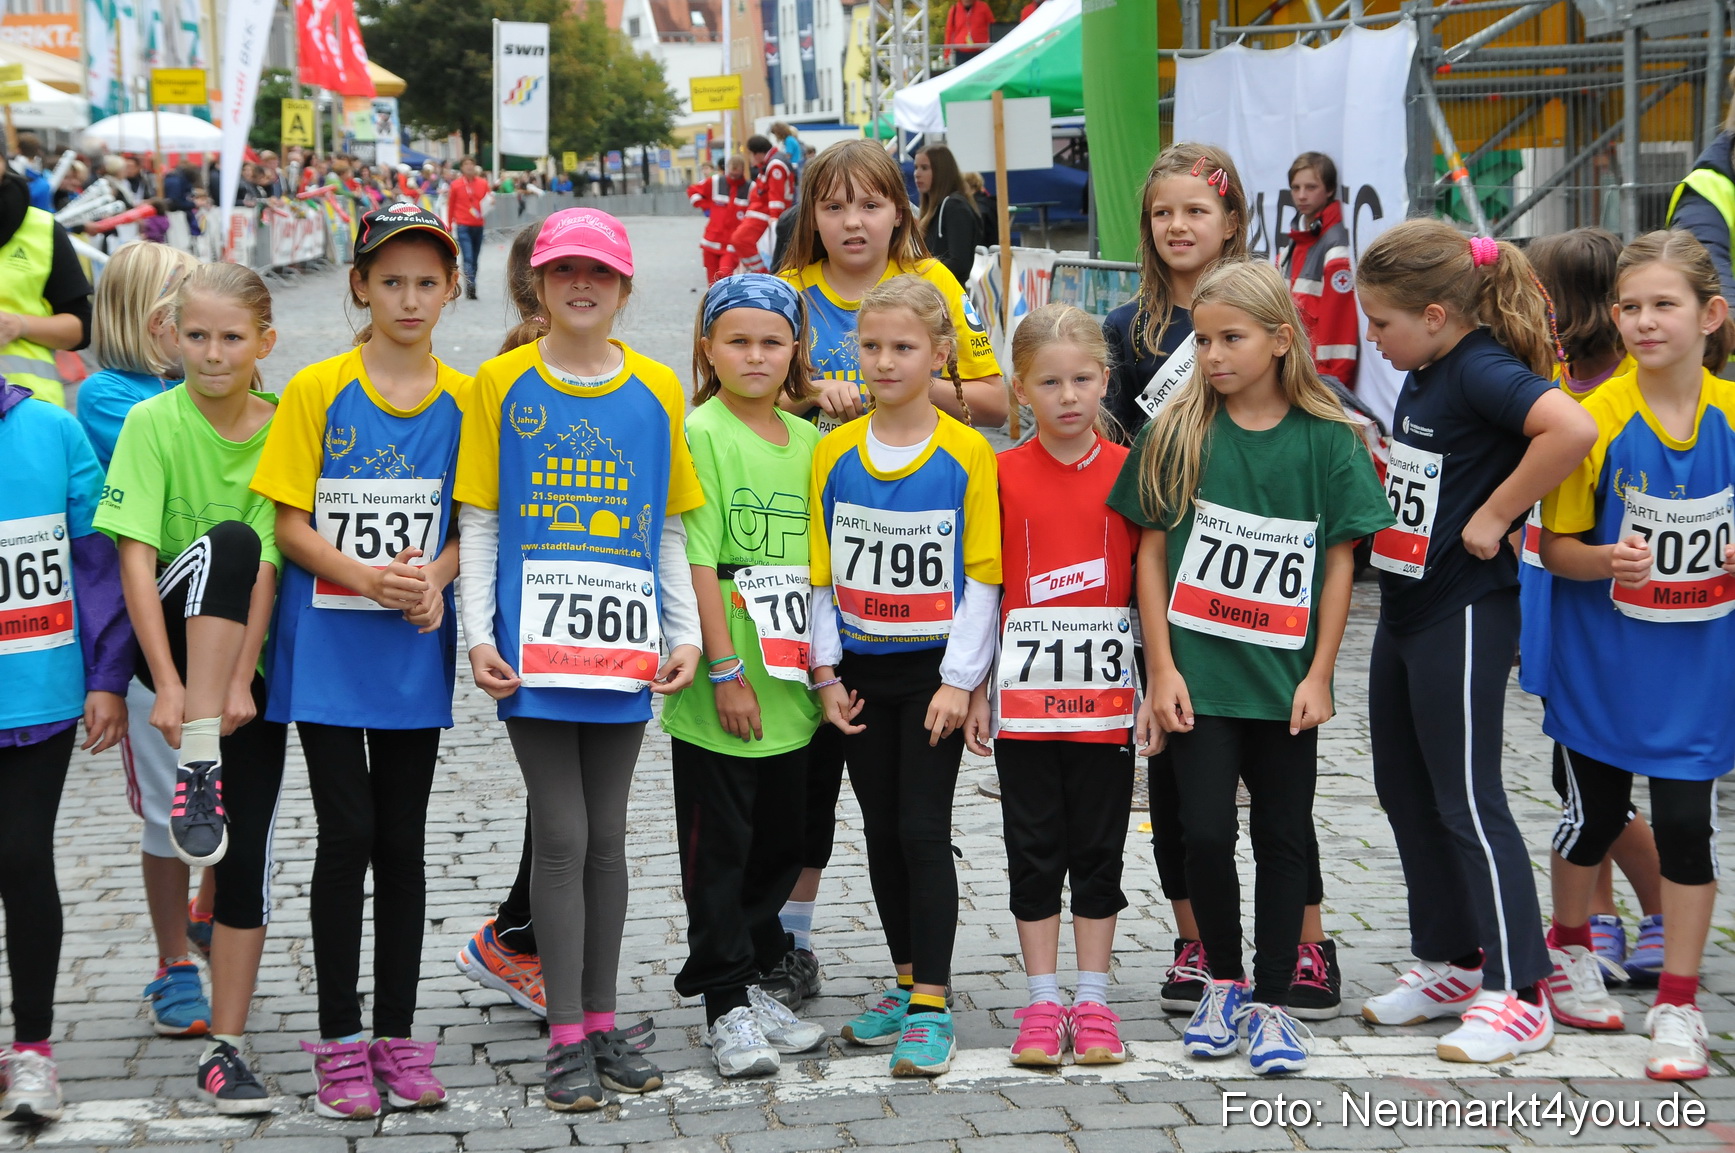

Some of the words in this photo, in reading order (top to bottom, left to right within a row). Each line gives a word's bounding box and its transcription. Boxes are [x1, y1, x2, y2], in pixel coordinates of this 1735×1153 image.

[289, 113, 306, 133] A
[375, 214, 439, 226] Deutschland
[970, 336, 991, 349] PAR
[972, 347, 993, 358] Neum
[1146, 378, 1179, 413] PARTL
[1174, 354, 1197, 377] Neu
[517, 416, 539, 425] Jahre
[1389, 455, 1420, 474] eumarkt
[318, 492, 358, 504] PARTL
[363, 493, 426, 504] Neumarkt
[605, 495, 628, 506] 2014
[1386, 472, 1426, 527] 55
[1626, 501, 1663, 523] PARTL
[1667, 507, 1725, 524] Neumarkt
[328, 511, 434, 559] 7537
[836, 515, 871, 532] PARTL
[873, 522, 931, 536] Neumarkt
[1196, 512, 1232, 534] PARTL
[1236, 525, 1299, 545] Neumarkt
[0, 531, 49, 548] eumarkt
[1632, 522, 1731, 575] 7020
[521, 543, 642, 558] www.stadtlauf-neumarkt.de
[844, 535, 943, 588] 7196
[1196, 534, 1305, 599] 7076
[526, 573, 573, 585] PARTL
[577, 574, 637, 592] Neumarkt
[739, 575, 783, 590] PARTL
[786, 574, 811, 585] Neum
[1050, 571, 1084, 591] DEHN
[1653, 587, 1708, 604] Maria
[864, 598, 910, 618] Elena
[1208, 598, 1270, 629] Svenja
[538, 593, 648, 643] 7560
[1007, 620, 1048, 633] PARTL
[1052, 620, 1113, 632] Neumarkt
[761, 628, 766, 637] 5
[798, 647, 808, 665] E
[1017, 639, 1122, 683] 7113
[1003, 680, 1009, 688] 5
[1044, 695, 1095, 713] Paula
